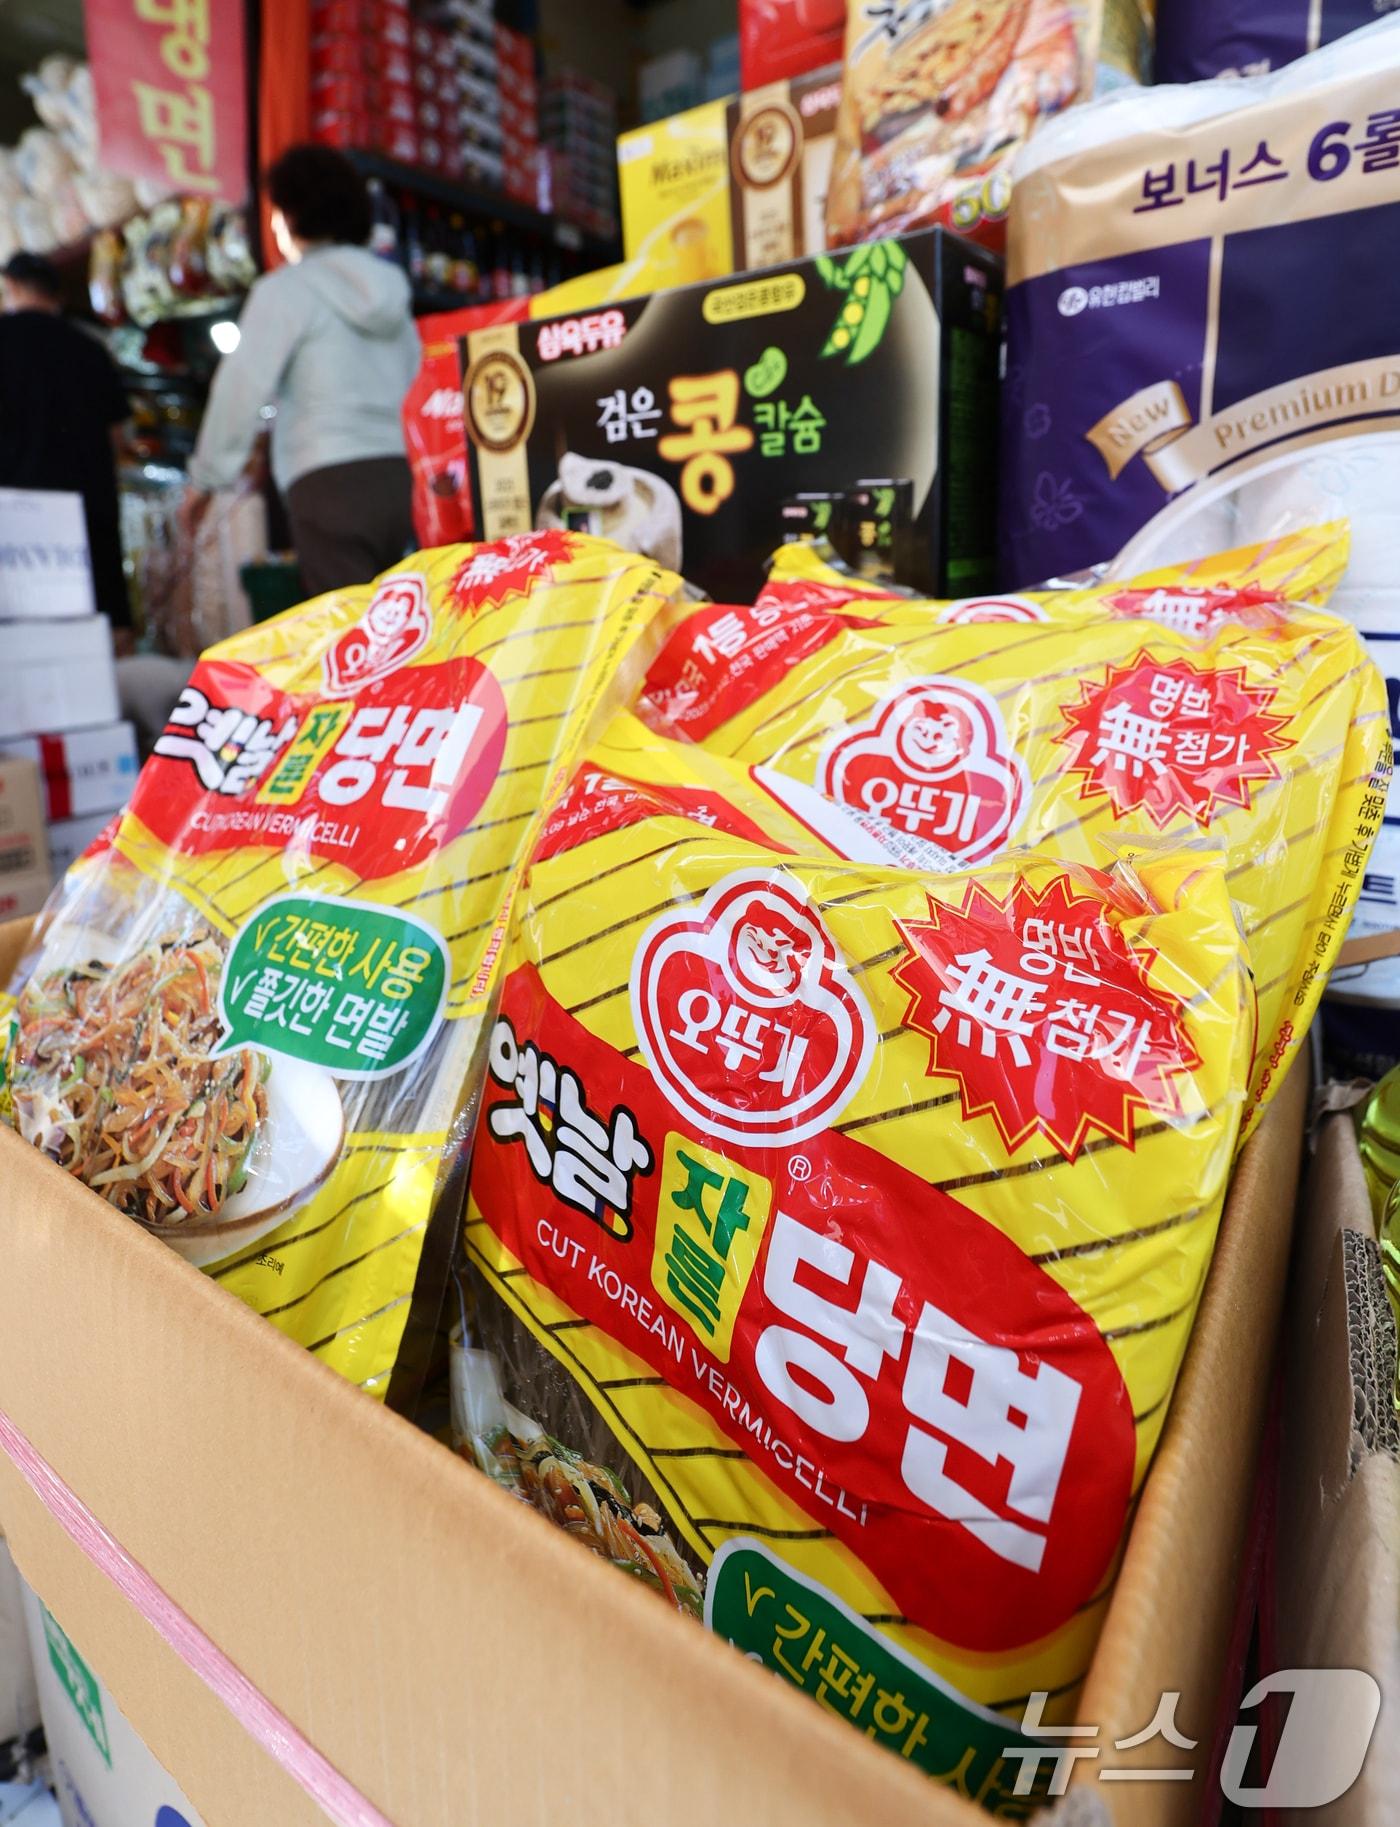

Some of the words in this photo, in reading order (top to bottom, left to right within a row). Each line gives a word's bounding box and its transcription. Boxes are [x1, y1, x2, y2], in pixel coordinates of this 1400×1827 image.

[1133, 140, 1289, 214] 보너스
[596, 386, 662, 443] 검은
[658, 367, 754, 515] 콩
[753, 394, 827, 457] 칼슘
[1108, 398, 1172, 447] New
[1213, 379, 1371, 451] Premium
[692, 611, 748, 665] 1등
[317, 704, 486, 815] 당면
[1089, 702, 1174, 778] 無
[1173, 732, 1251, 766] 첨가
[860, 776, 982, 843] 오뚜기
[1353, 822, 1375, 838] 후
[1357, 793, 1386, 821] 맞춘
[267, 913, 360, 979] 간편한
[348, 937, 433, 1001] 사용
[1018, 917, 1102, 987] 명반
[244, 966, 336, 1037] 쫄깃한
[324, 990, 410, 1062] 면발
[669, 988, 809, 1098] 오뚜기
[931, 948, 1049, 1068] 無
[1046, 997, 1153, 1082] 첨가
[488, 1018, 653, 1242] 옛날
[662, 1150, 752, 1338] 자른
[754, 1209, 1084, 1574] 당면
[536, 1218, 587, 1269] CUT
[587, 1261, 688, 1363] KOREAN
[690, 1347, 868, 1528] VERMICELLI
